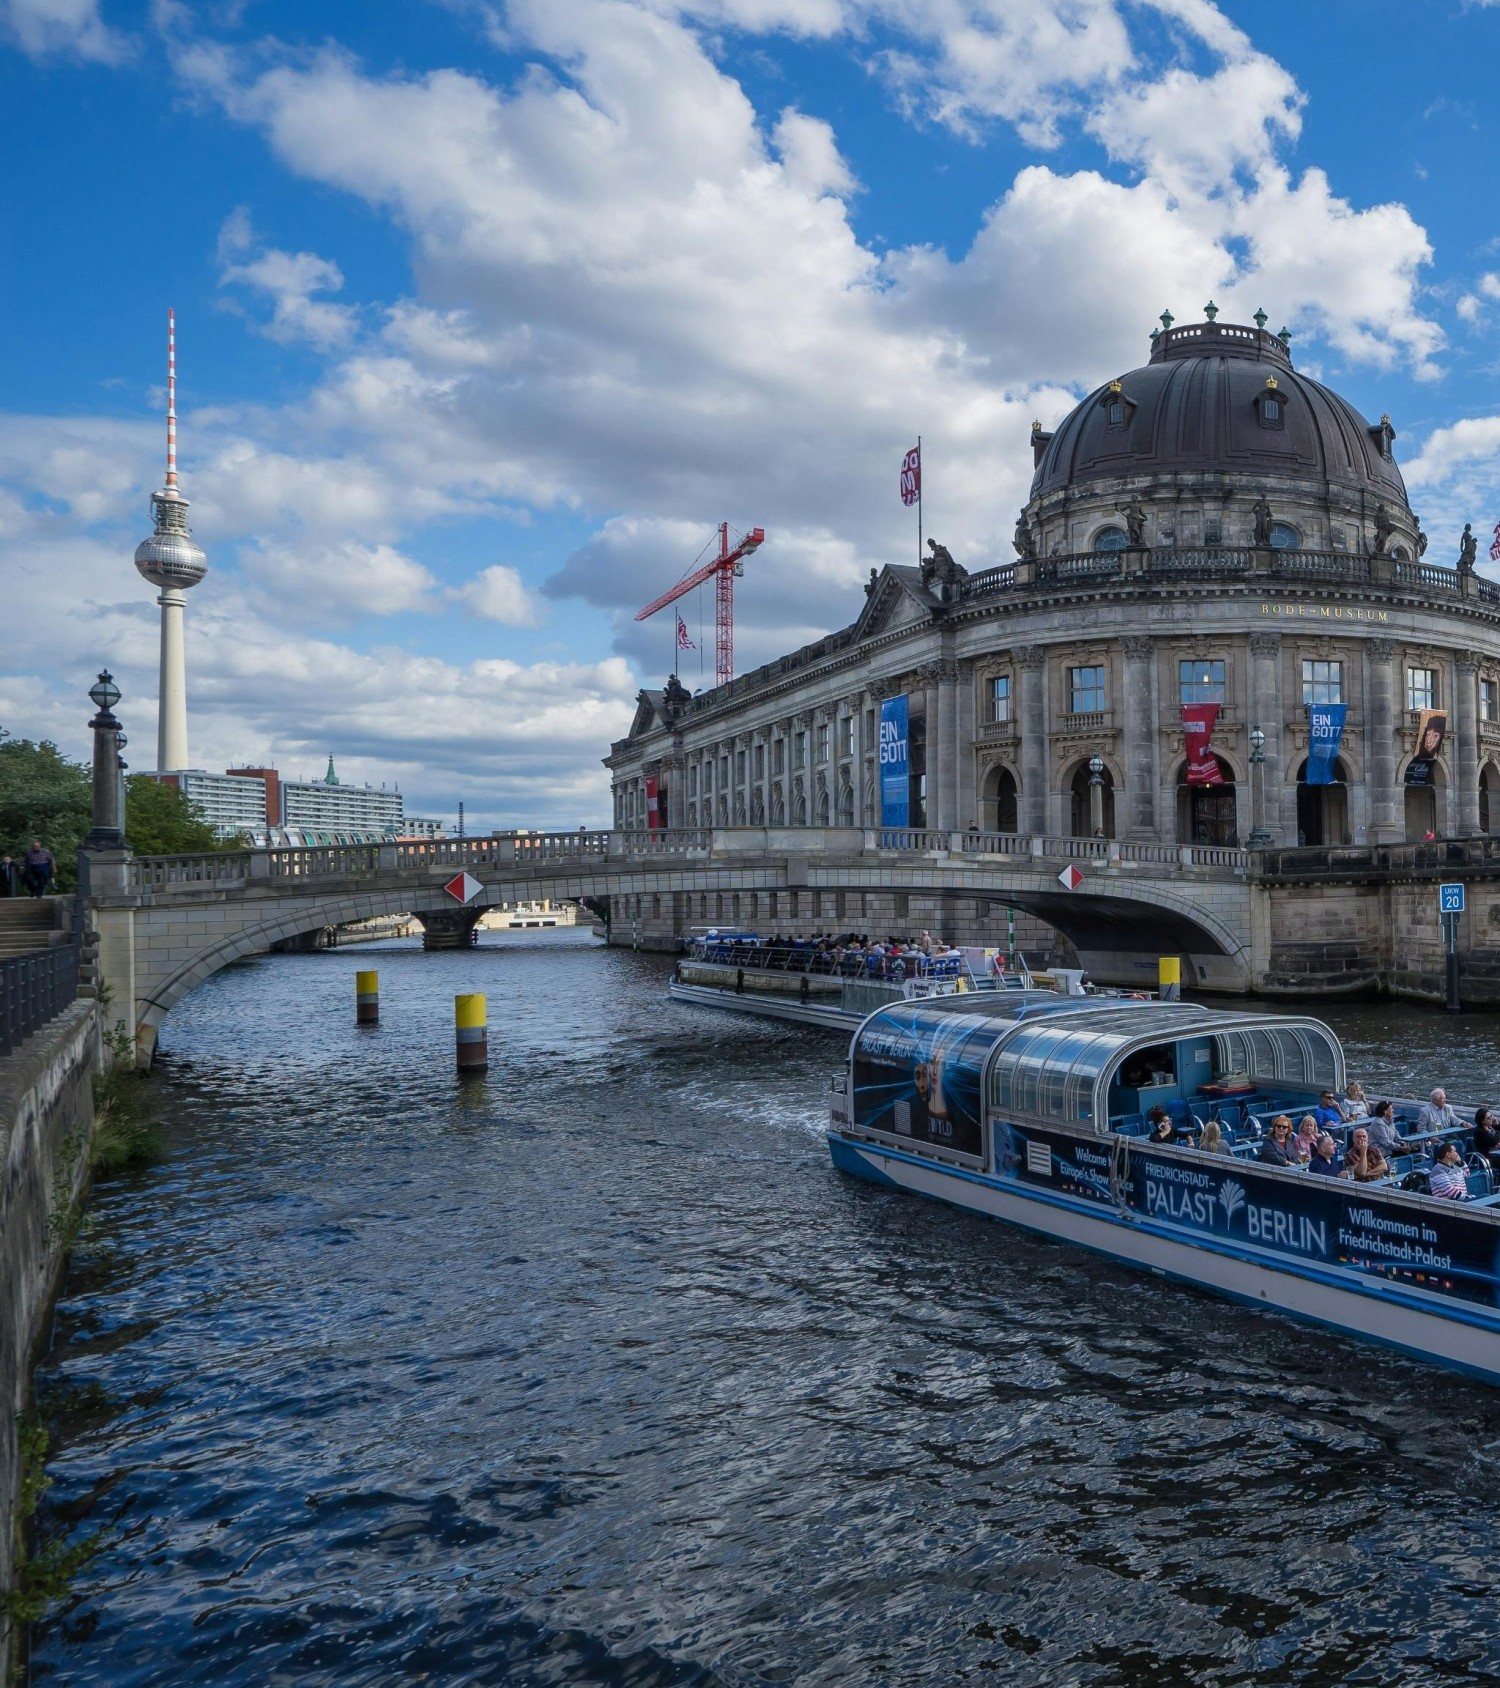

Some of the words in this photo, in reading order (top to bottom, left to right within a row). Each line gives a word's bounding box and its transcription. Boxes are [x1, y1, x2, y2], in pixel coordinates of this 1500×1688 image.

[1262, 604, 1387, 622] BODE-MUSEUM
[1312, 714, 1331, 727] EIN
[880, 720, 898, 743] EIN
[1312, 726, 1341, 738] GOTT
[880, 739, 907, 764] GOTT
[1444, 887, 1460, 895] UKW
[1446, 895, 1459, 908] 20
[1075, 1146, 1107, 1166] Welcome
[1090, 1168, 1110, 1185] Show
[1146, 1180, 1217, 1226] PALAST
[1247, 1204, 1327, 1255] BERLIN
[1349, 1207, 1419, 1239] Willkommen
[1422, 1222, 1437, 1243] im
[1339, 1228, 1451, 1269] Friedrichstadt-Palast
